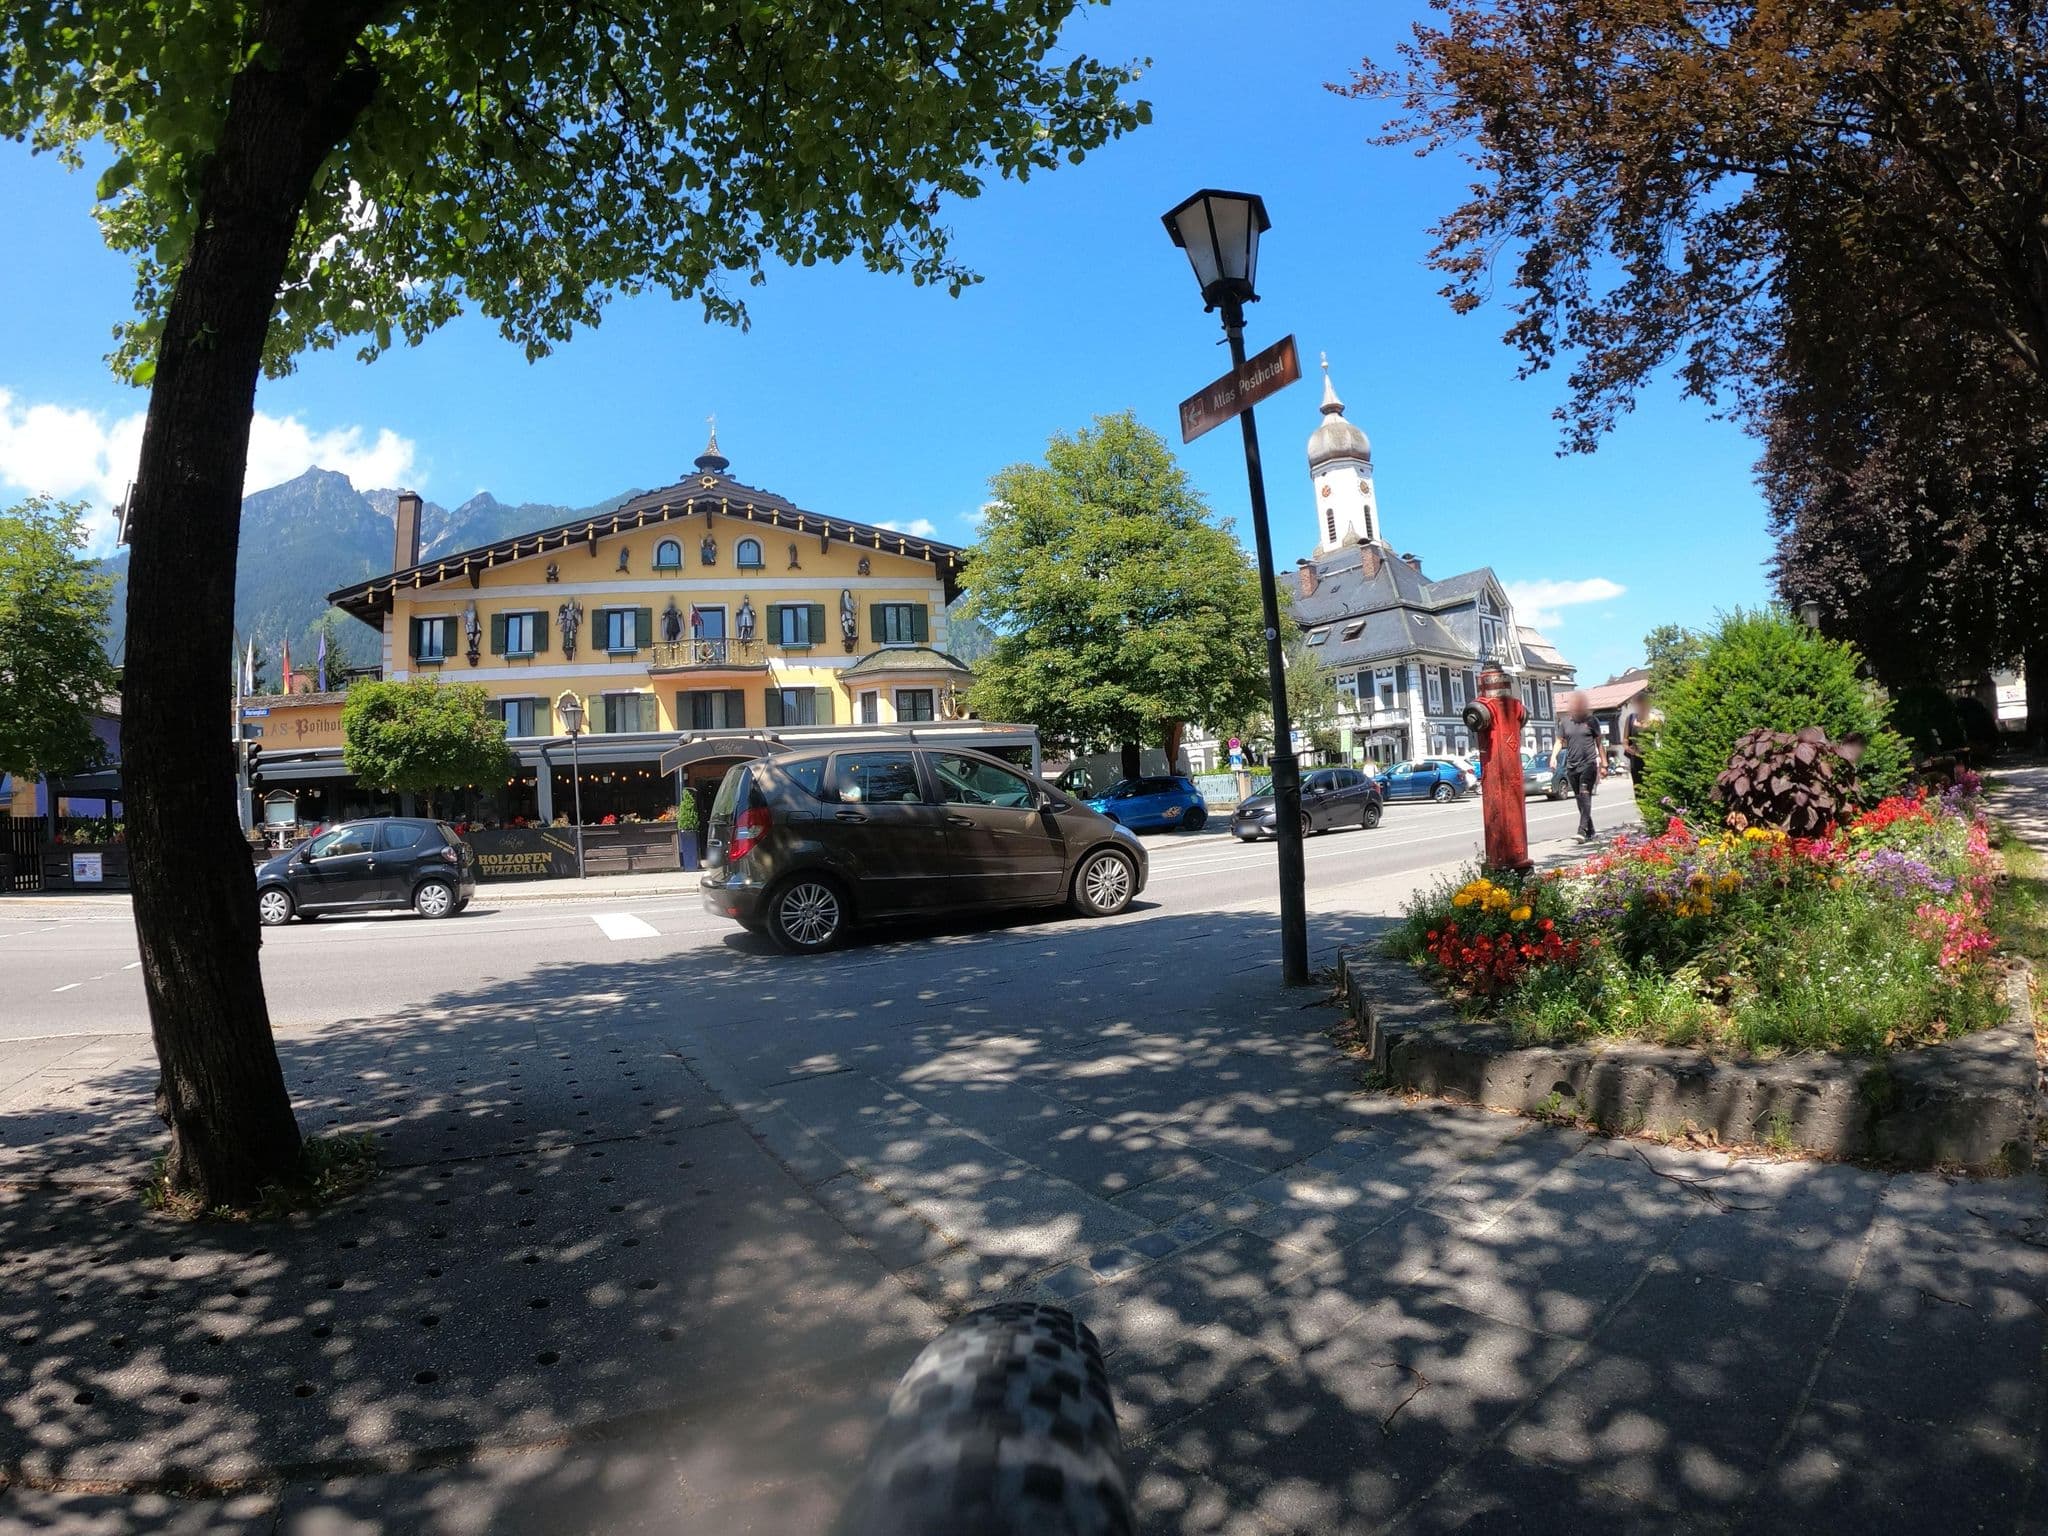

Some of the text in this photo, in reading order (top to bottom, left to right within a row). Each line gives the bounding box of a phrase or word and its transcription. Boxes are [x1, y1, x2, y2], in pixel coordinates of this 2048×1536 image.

[1213, 355, 1285, 411] Atlas Posthotel
[478, 852, 553, 865] HOLZOFEN
[482, 863, 549, 876] PIZZERIA
